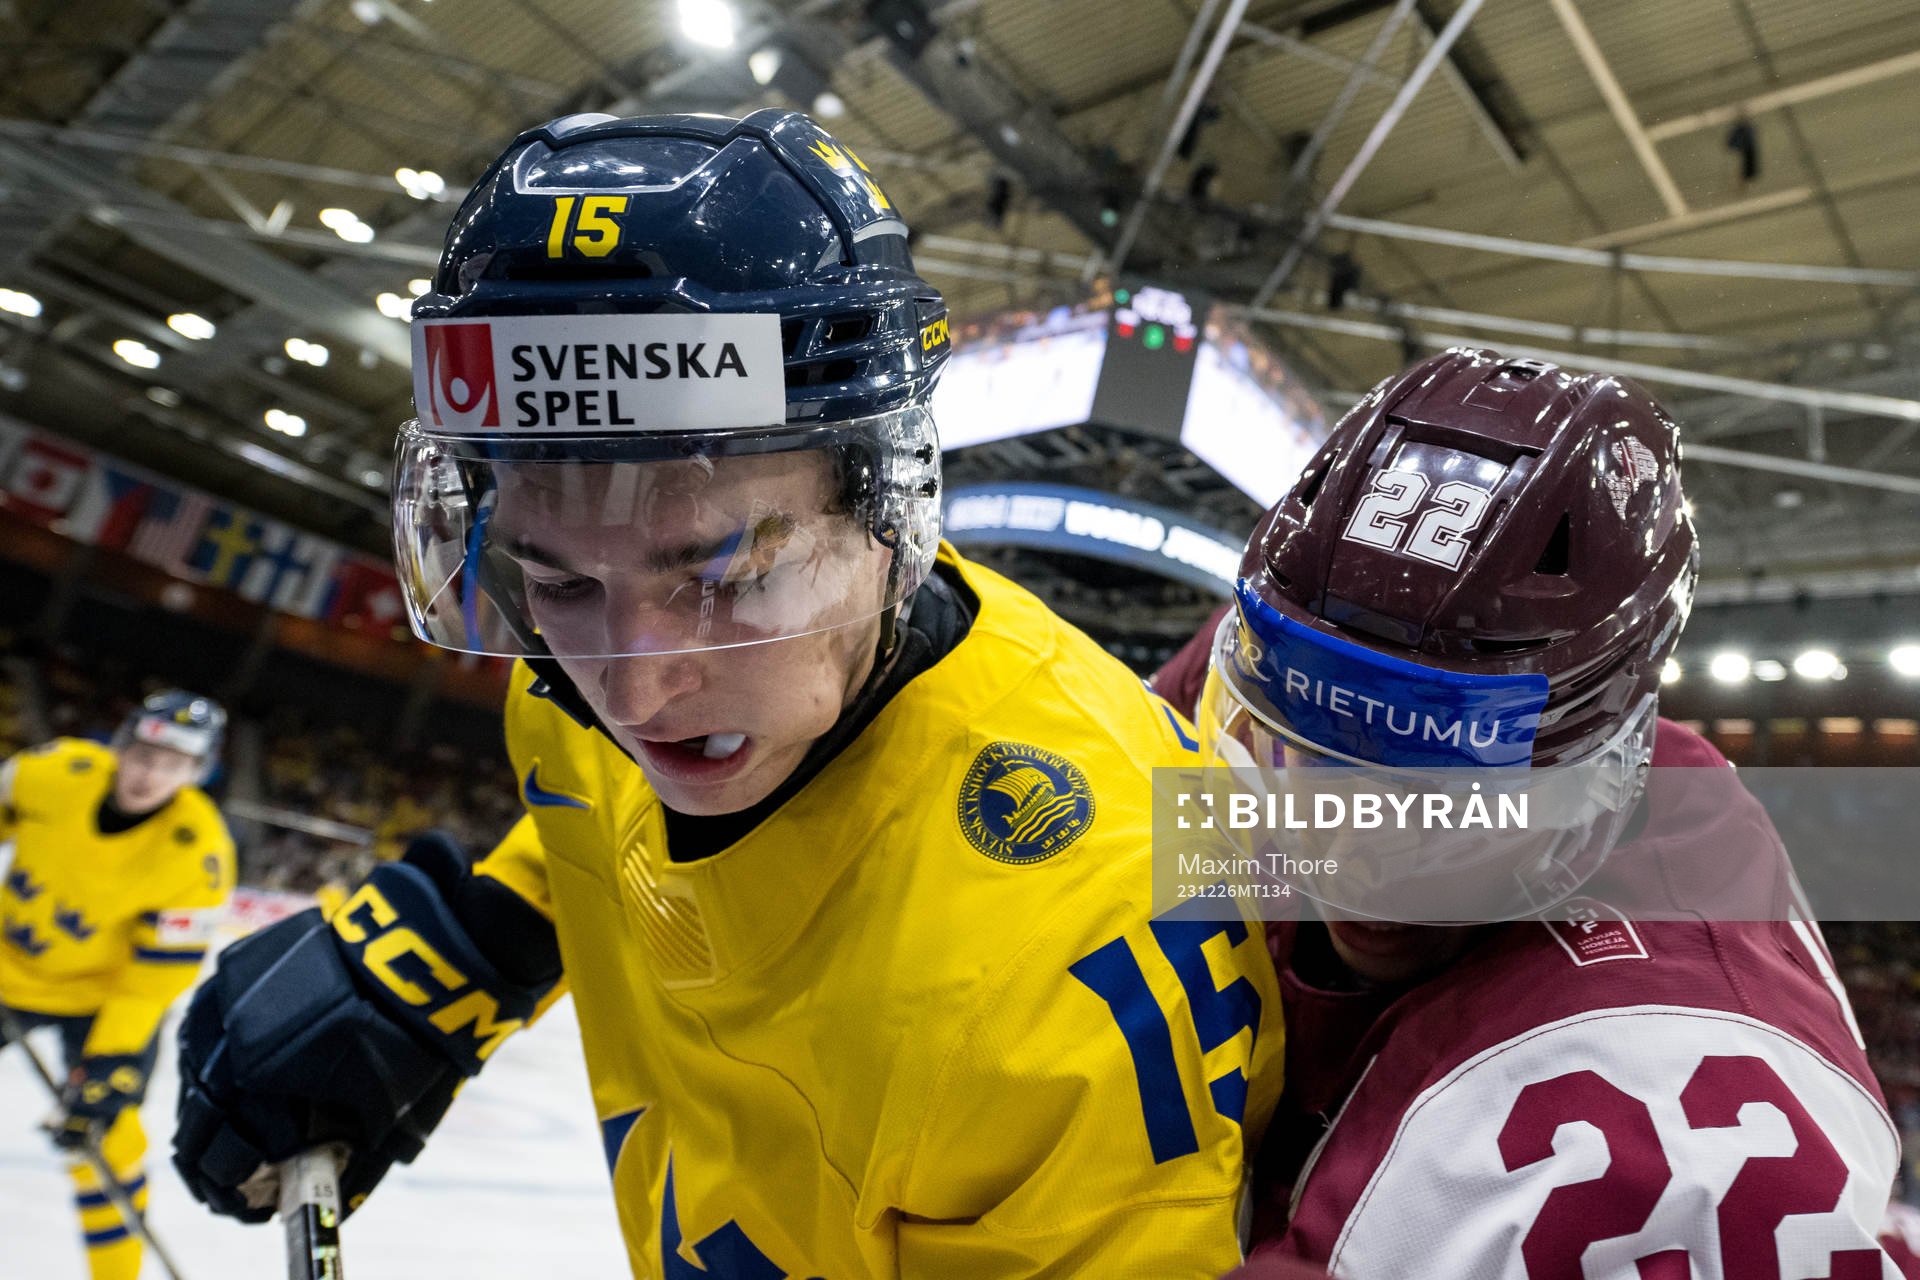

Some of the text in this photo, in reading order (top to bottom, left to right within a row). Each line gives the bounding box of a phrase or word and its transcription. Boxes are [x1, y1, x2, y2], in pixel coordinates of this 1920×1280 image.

[546, 196, 629, 259] 15
[511, 341, 749, 382] SVENSKA
[922, 317, 950, 351] CCM
[516, 390, 636, 428] SPEL
[1341, 468, 1493, 573] 22
[1285, 666, 1501, 749] RIETUMU
[332, 883, 523, 1061] CCM
[1067, 878, 1263, 1165] 15
[1497, 1055, 1885, 1280] 22
